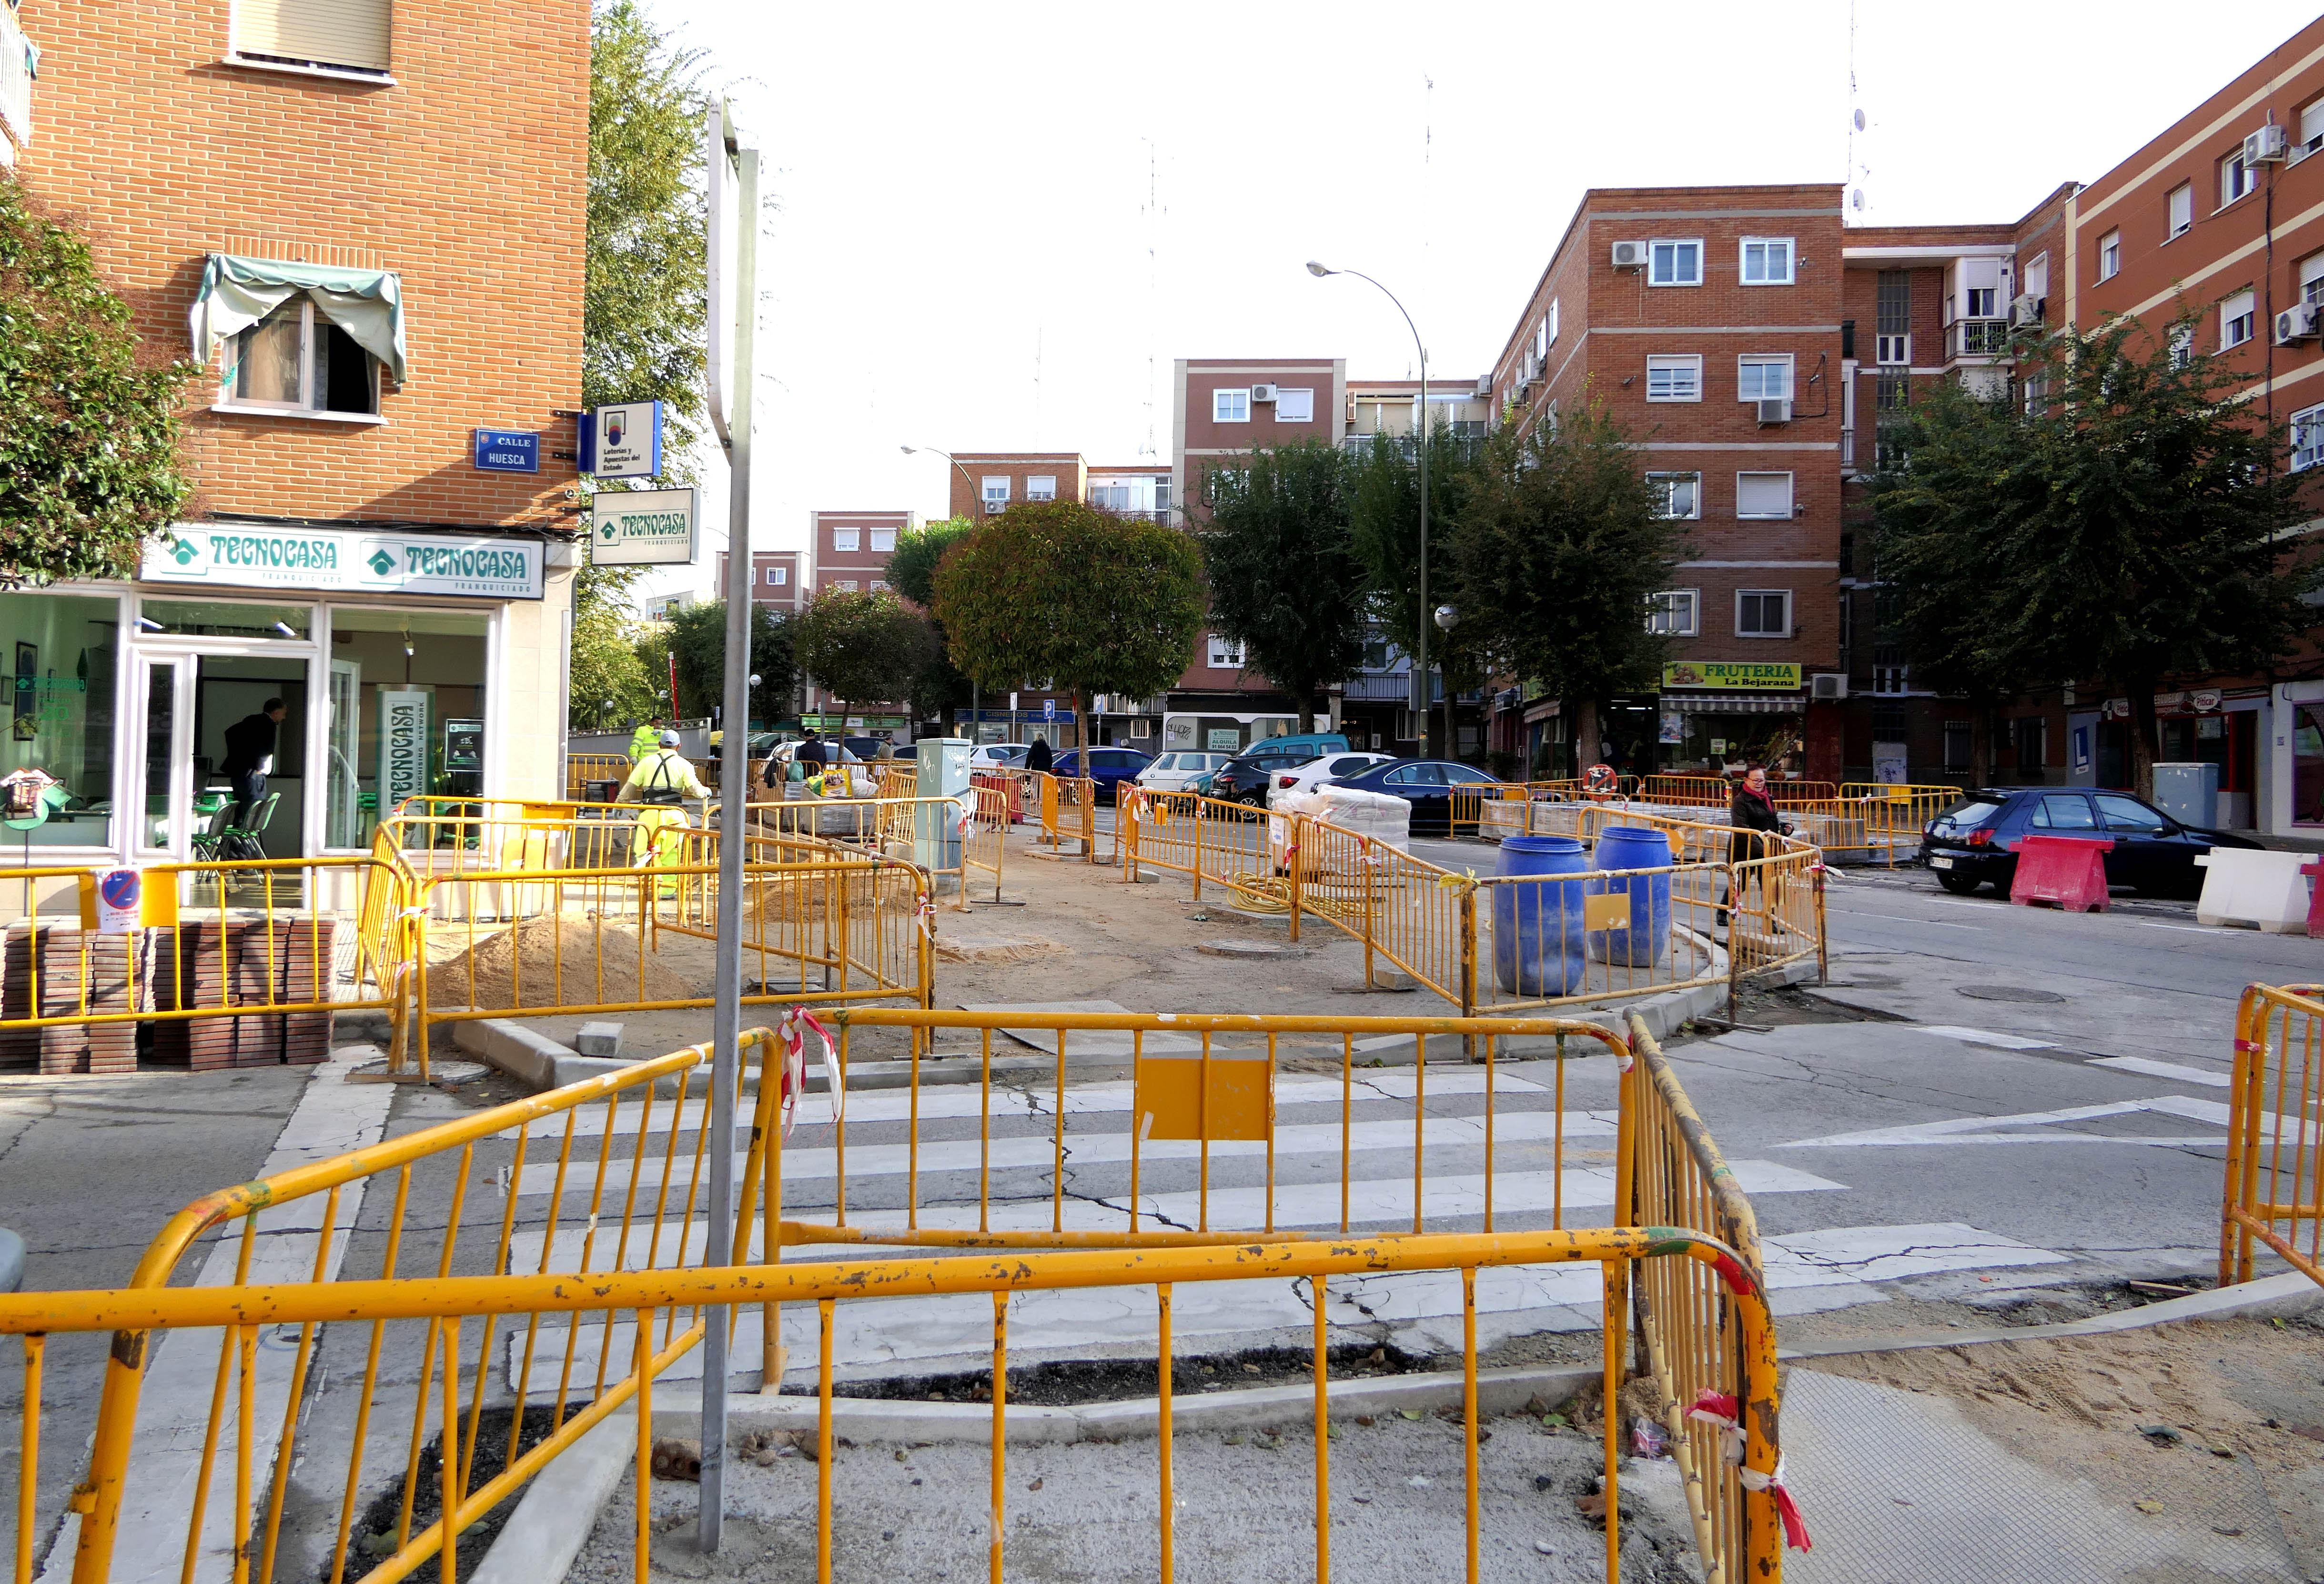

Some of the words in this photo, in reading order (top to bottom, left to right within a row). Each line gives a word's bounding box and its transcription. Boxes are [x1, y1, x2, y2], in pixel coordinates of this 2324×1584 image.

[498, 437, 531, 447] CALLE
[489, 453, 525, 465] HUESCA
[621, 513, 686, 536] TECNOCASA
[210, 536, 337, 569] TECNOCASA
[406, 547, 525, 579] TECNOCASA
[263, 573, 342, 583] FRANQUICIADO
[455, 582, 531, 592] FRANQUICIADO
[1704, 664, 1794, 678] FRUTERIA
[1741, 679, 1794, 687] Bejarana
[2197, 696, 2214, 707] Piticar
[1045, 702, 1052, 716] P
[391, 705, 414, 805] TECNOCASA
